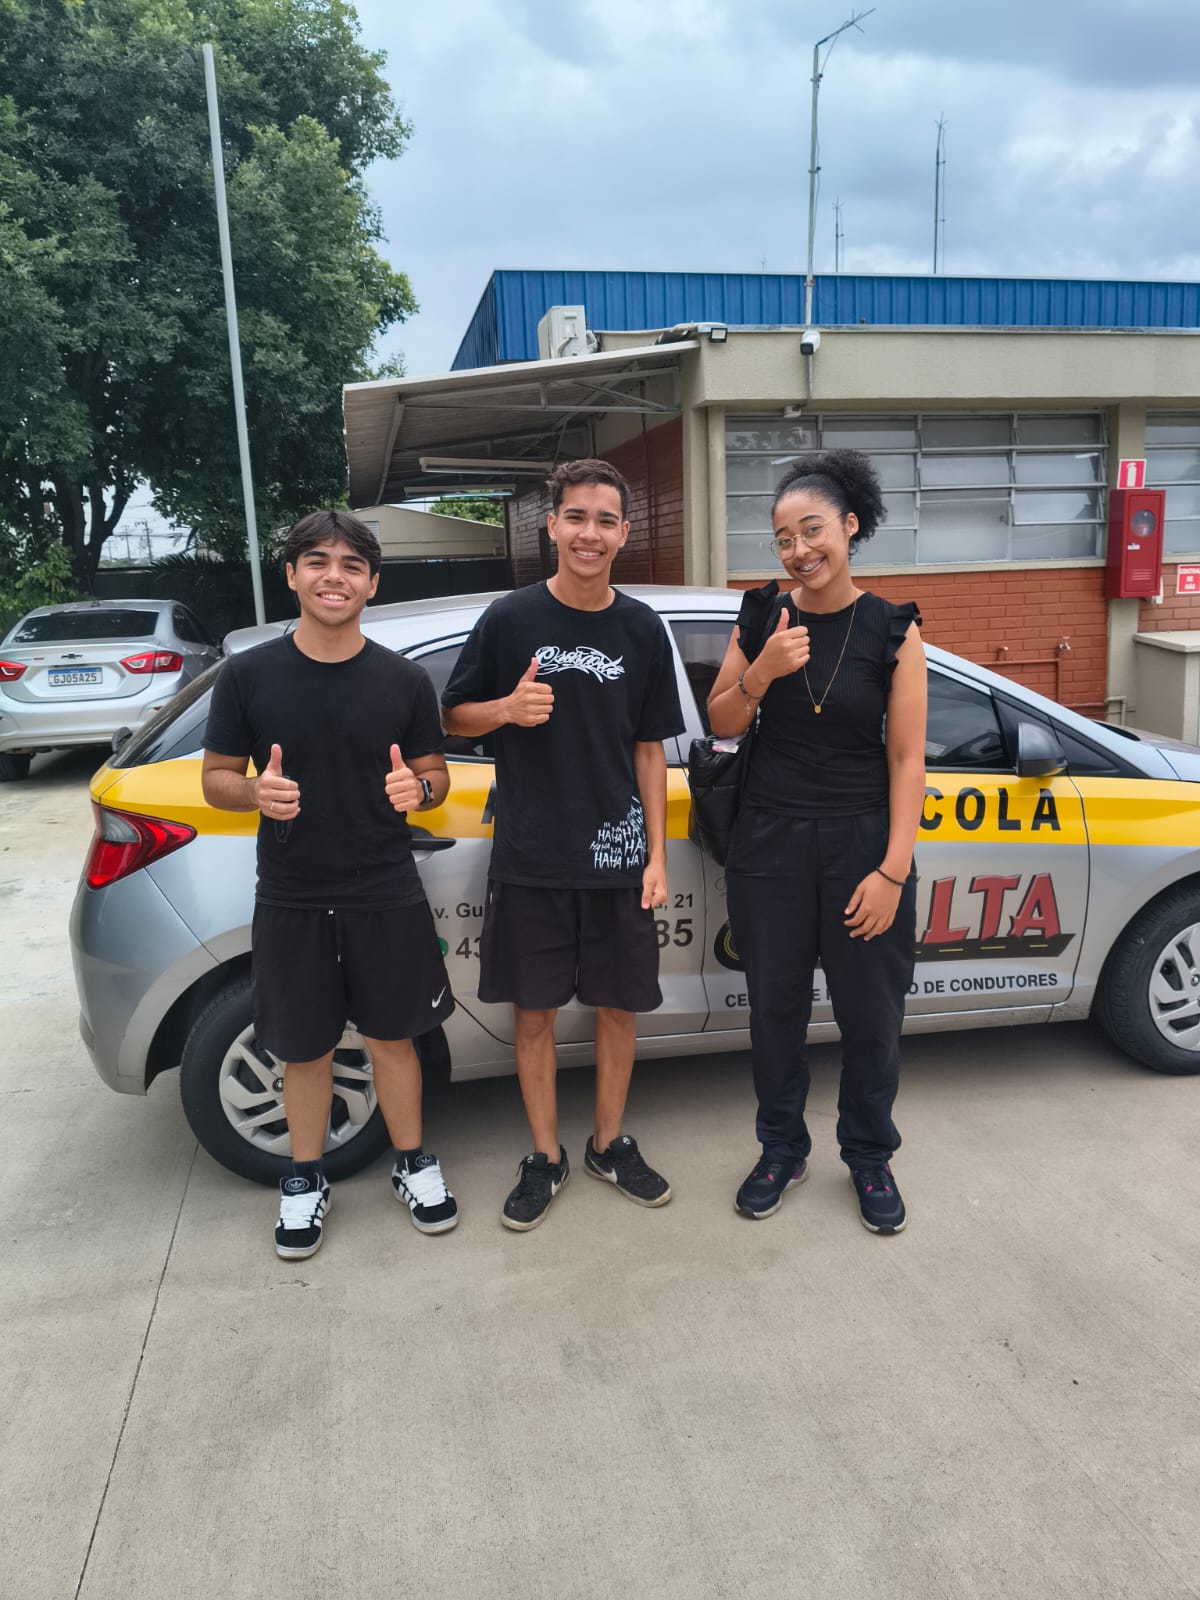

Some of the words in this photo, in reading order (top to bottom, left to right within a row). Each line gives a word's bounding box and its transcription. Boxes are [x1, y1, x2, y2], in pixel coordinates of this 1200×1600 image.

[919, 786, 1061, 831] COLA
[598, 829, 612, 842] HA
[627, 855, 639, 869] HA
[434, 907, 449, 919] v.
[455, 902, 483, 918] Gu
[674, 893, 693, 908] 21
[919, 872, 1062, 944] LTA
[724, 994, 748, 1008] CE
[923, 980, 945, 994] DE
[950, 972, 1058, 992] CONDUTORES
